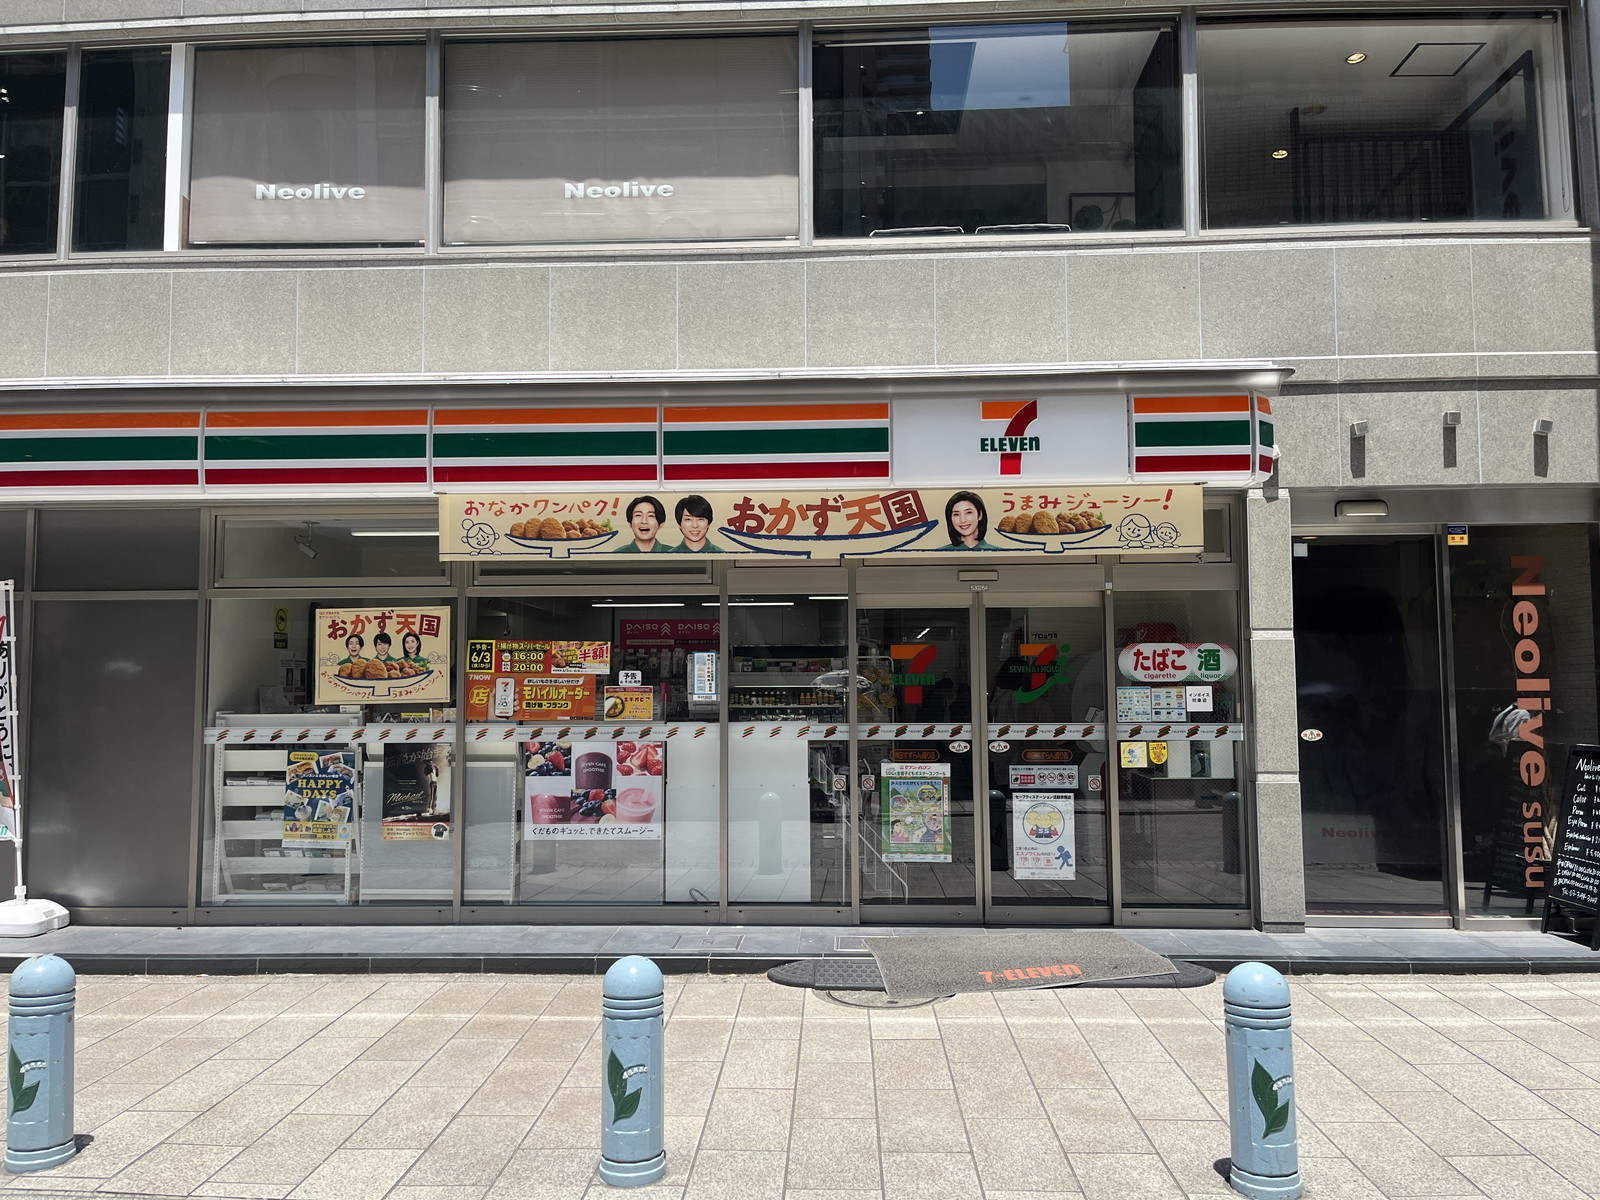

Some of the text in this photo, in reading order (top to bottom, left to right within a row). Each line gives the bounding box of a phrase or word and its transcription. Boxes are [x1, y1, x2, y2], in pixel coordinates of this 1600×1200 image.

[255, 183, 366, 200] Neolive
[564, 181, 675, 199] Neolive
[1001, 488, 1174, 513] うまみジューシー!
[464, 497, 621, 518] おなかワンパク!
[726, 490, 930, 536] おかず天国
[327, 609, 442, 641] おかず天国
[471, 652, 490, 662] 6/3
[513, 652, 544, 661] 16:00
[578, 645, 609, 662] 半額!
[1133, 647, 1187, 672] たばこ
[1197, 648, 1221, 672] 酒
[513, 663, 544, 672] 20:00
[1144, 672, 1177, 680] cigarette
[1200, 672, 1222, 680] liquor
[522, 686, 590, 700] モバイルオーダー
[1510, 555, 1552, 889] Neolive susu
[297, 779, 343, 788] HAPPY
[1576, 783, 1587, 792] Cut
[302, 789, 337, 799] DAYS
[1572, 793, 1587, 804] Color
[1571, 805, 1584, 816] Perm
[531, 826, 655, 836] くだものギュッと、できたてスムージー
